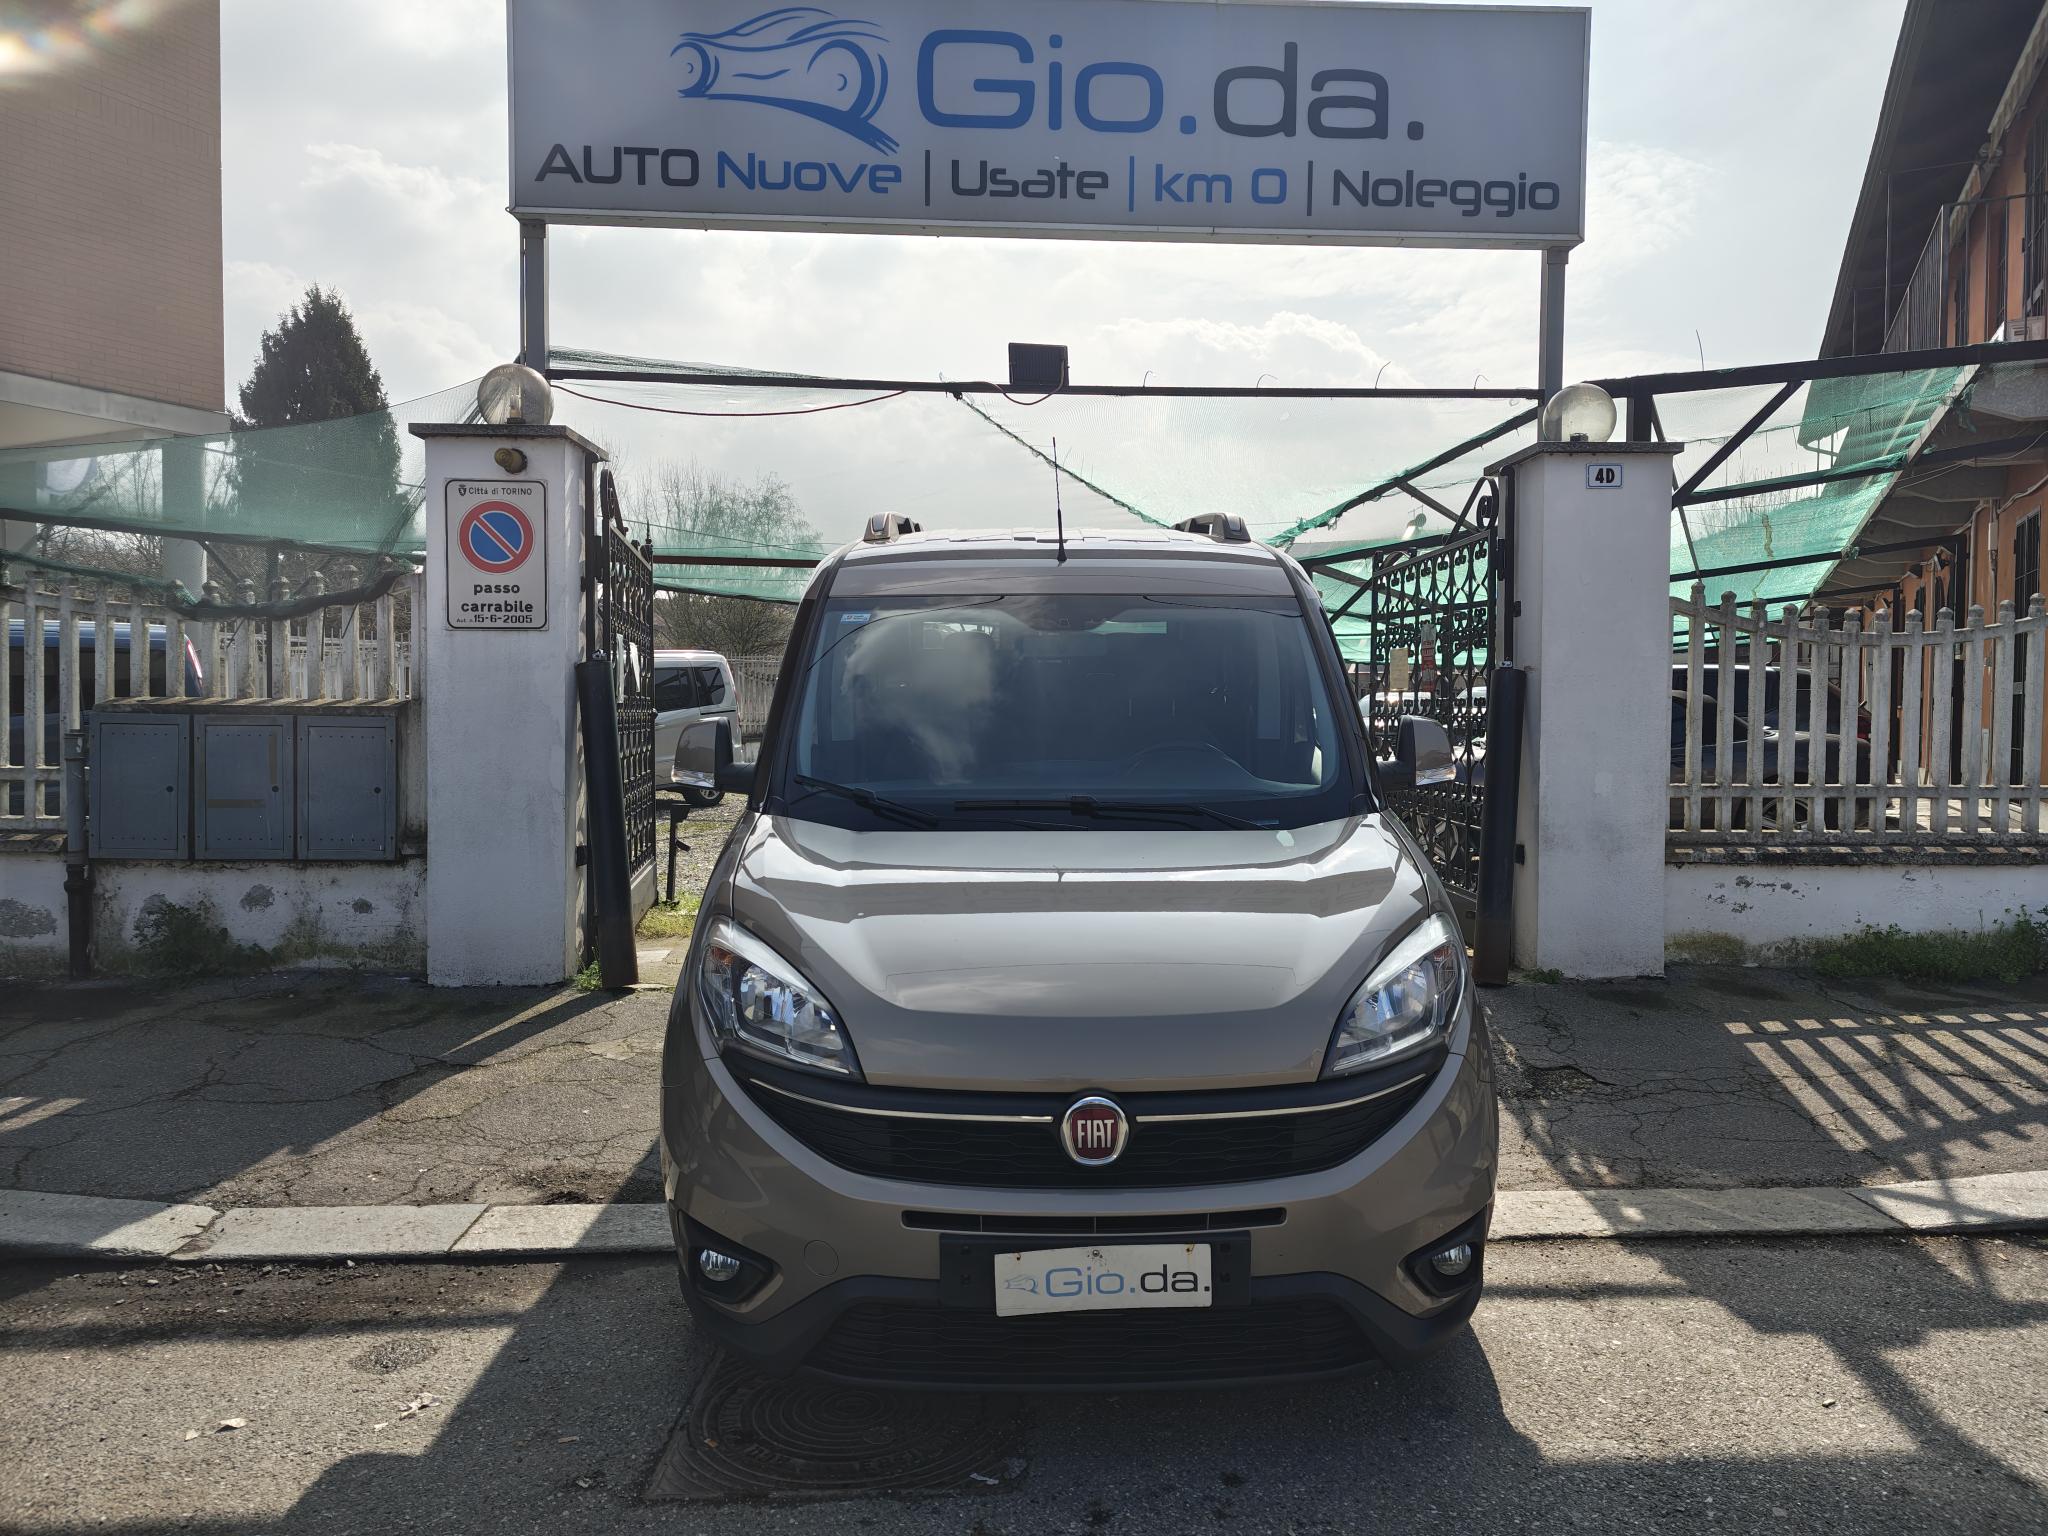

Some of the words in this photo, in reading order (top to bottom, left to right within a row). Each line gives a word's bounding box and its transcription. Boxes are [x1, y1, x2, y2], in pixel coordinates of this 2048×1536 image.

[916, 29, 1425, 141] Gio.da.
[534, 143, 699, 187] AUTO
[717, 151, 902, 193] Nuove
[951, 159, 1109, 200] Usate
[1154, 163, 1232, 203] km
[1332, 168, 1560, 217] Noleggio
[1594, 467, 1616, 484] 4D
[491, 487, 499, 495] di
[501, 487, 533, 496] TORINO
[473, 583, 520, 596] passo
[461, 600, 533, 613] carrabile
[1077, 1119, 1114, 1149] FIAT
[1045, 1264, 1210, 1298] Gio.da.
